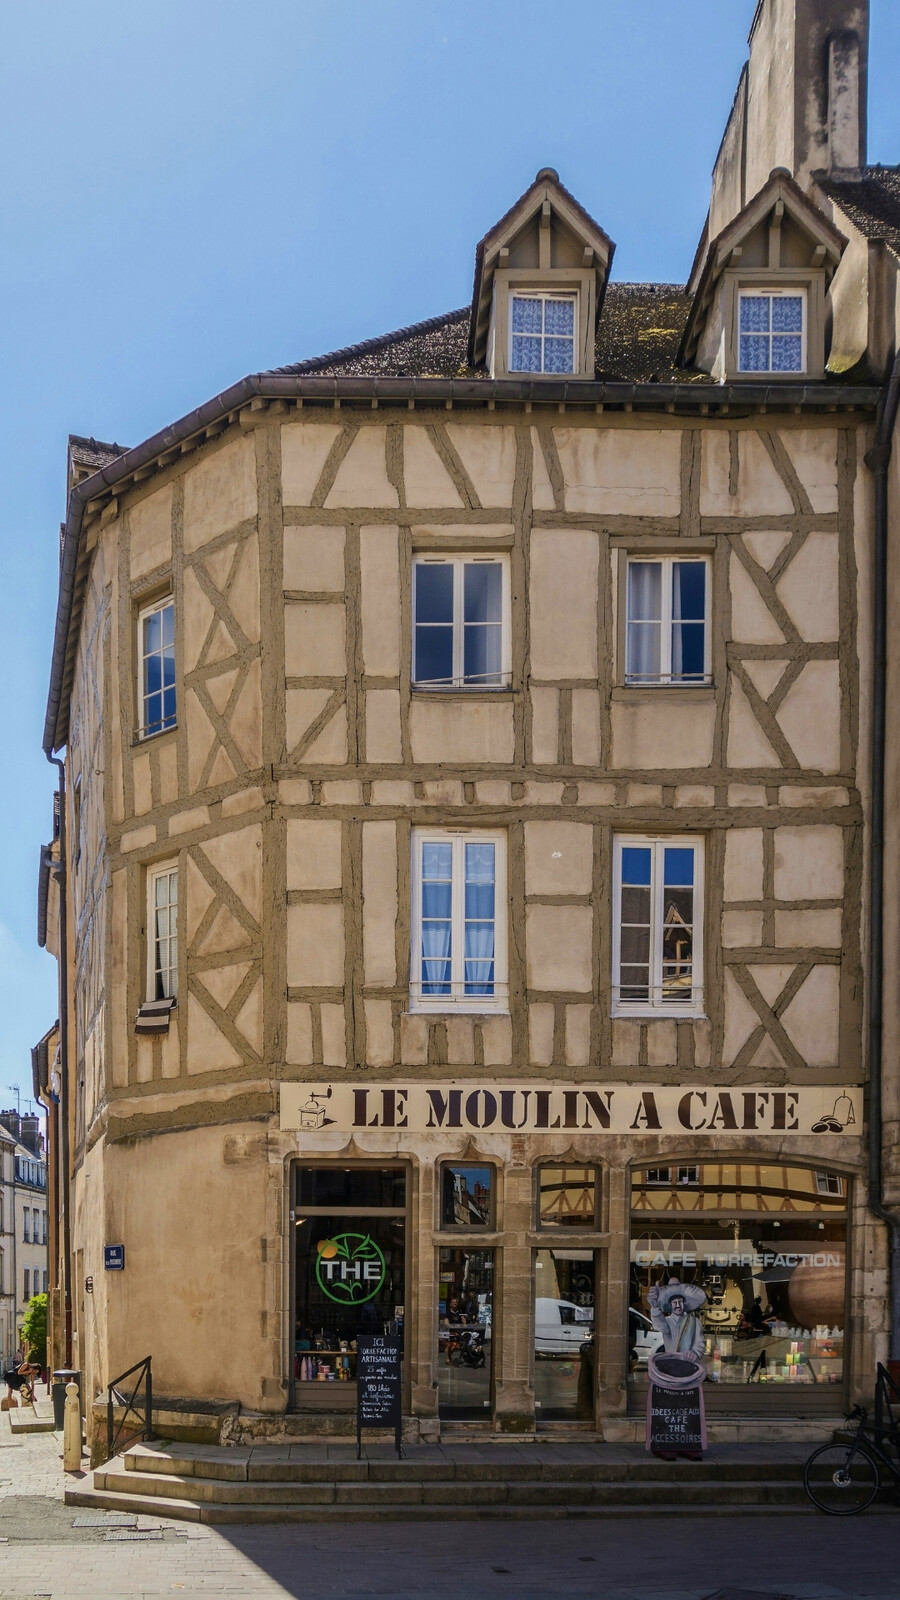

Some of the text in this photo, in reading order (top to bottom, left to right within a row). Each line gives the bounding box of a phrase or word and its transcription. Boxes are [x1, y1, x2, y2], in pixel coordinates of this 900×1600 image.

[352, 1089, 799, 1130] LE MOULIN A CAFE
[635, 1253, 840, 1267] CAFE TORREFACTION
[320, 1261, 381, 1279] THE
[373, 1337, 384, 1346] ICI
[361, 1355, 397, 1363] ARTISANALE
[664, 1416, 688, 1424] CAFE
[669, 1424, 686, 1433] THE
[651, 1434, 702, 1443] ACCESSOIRES
